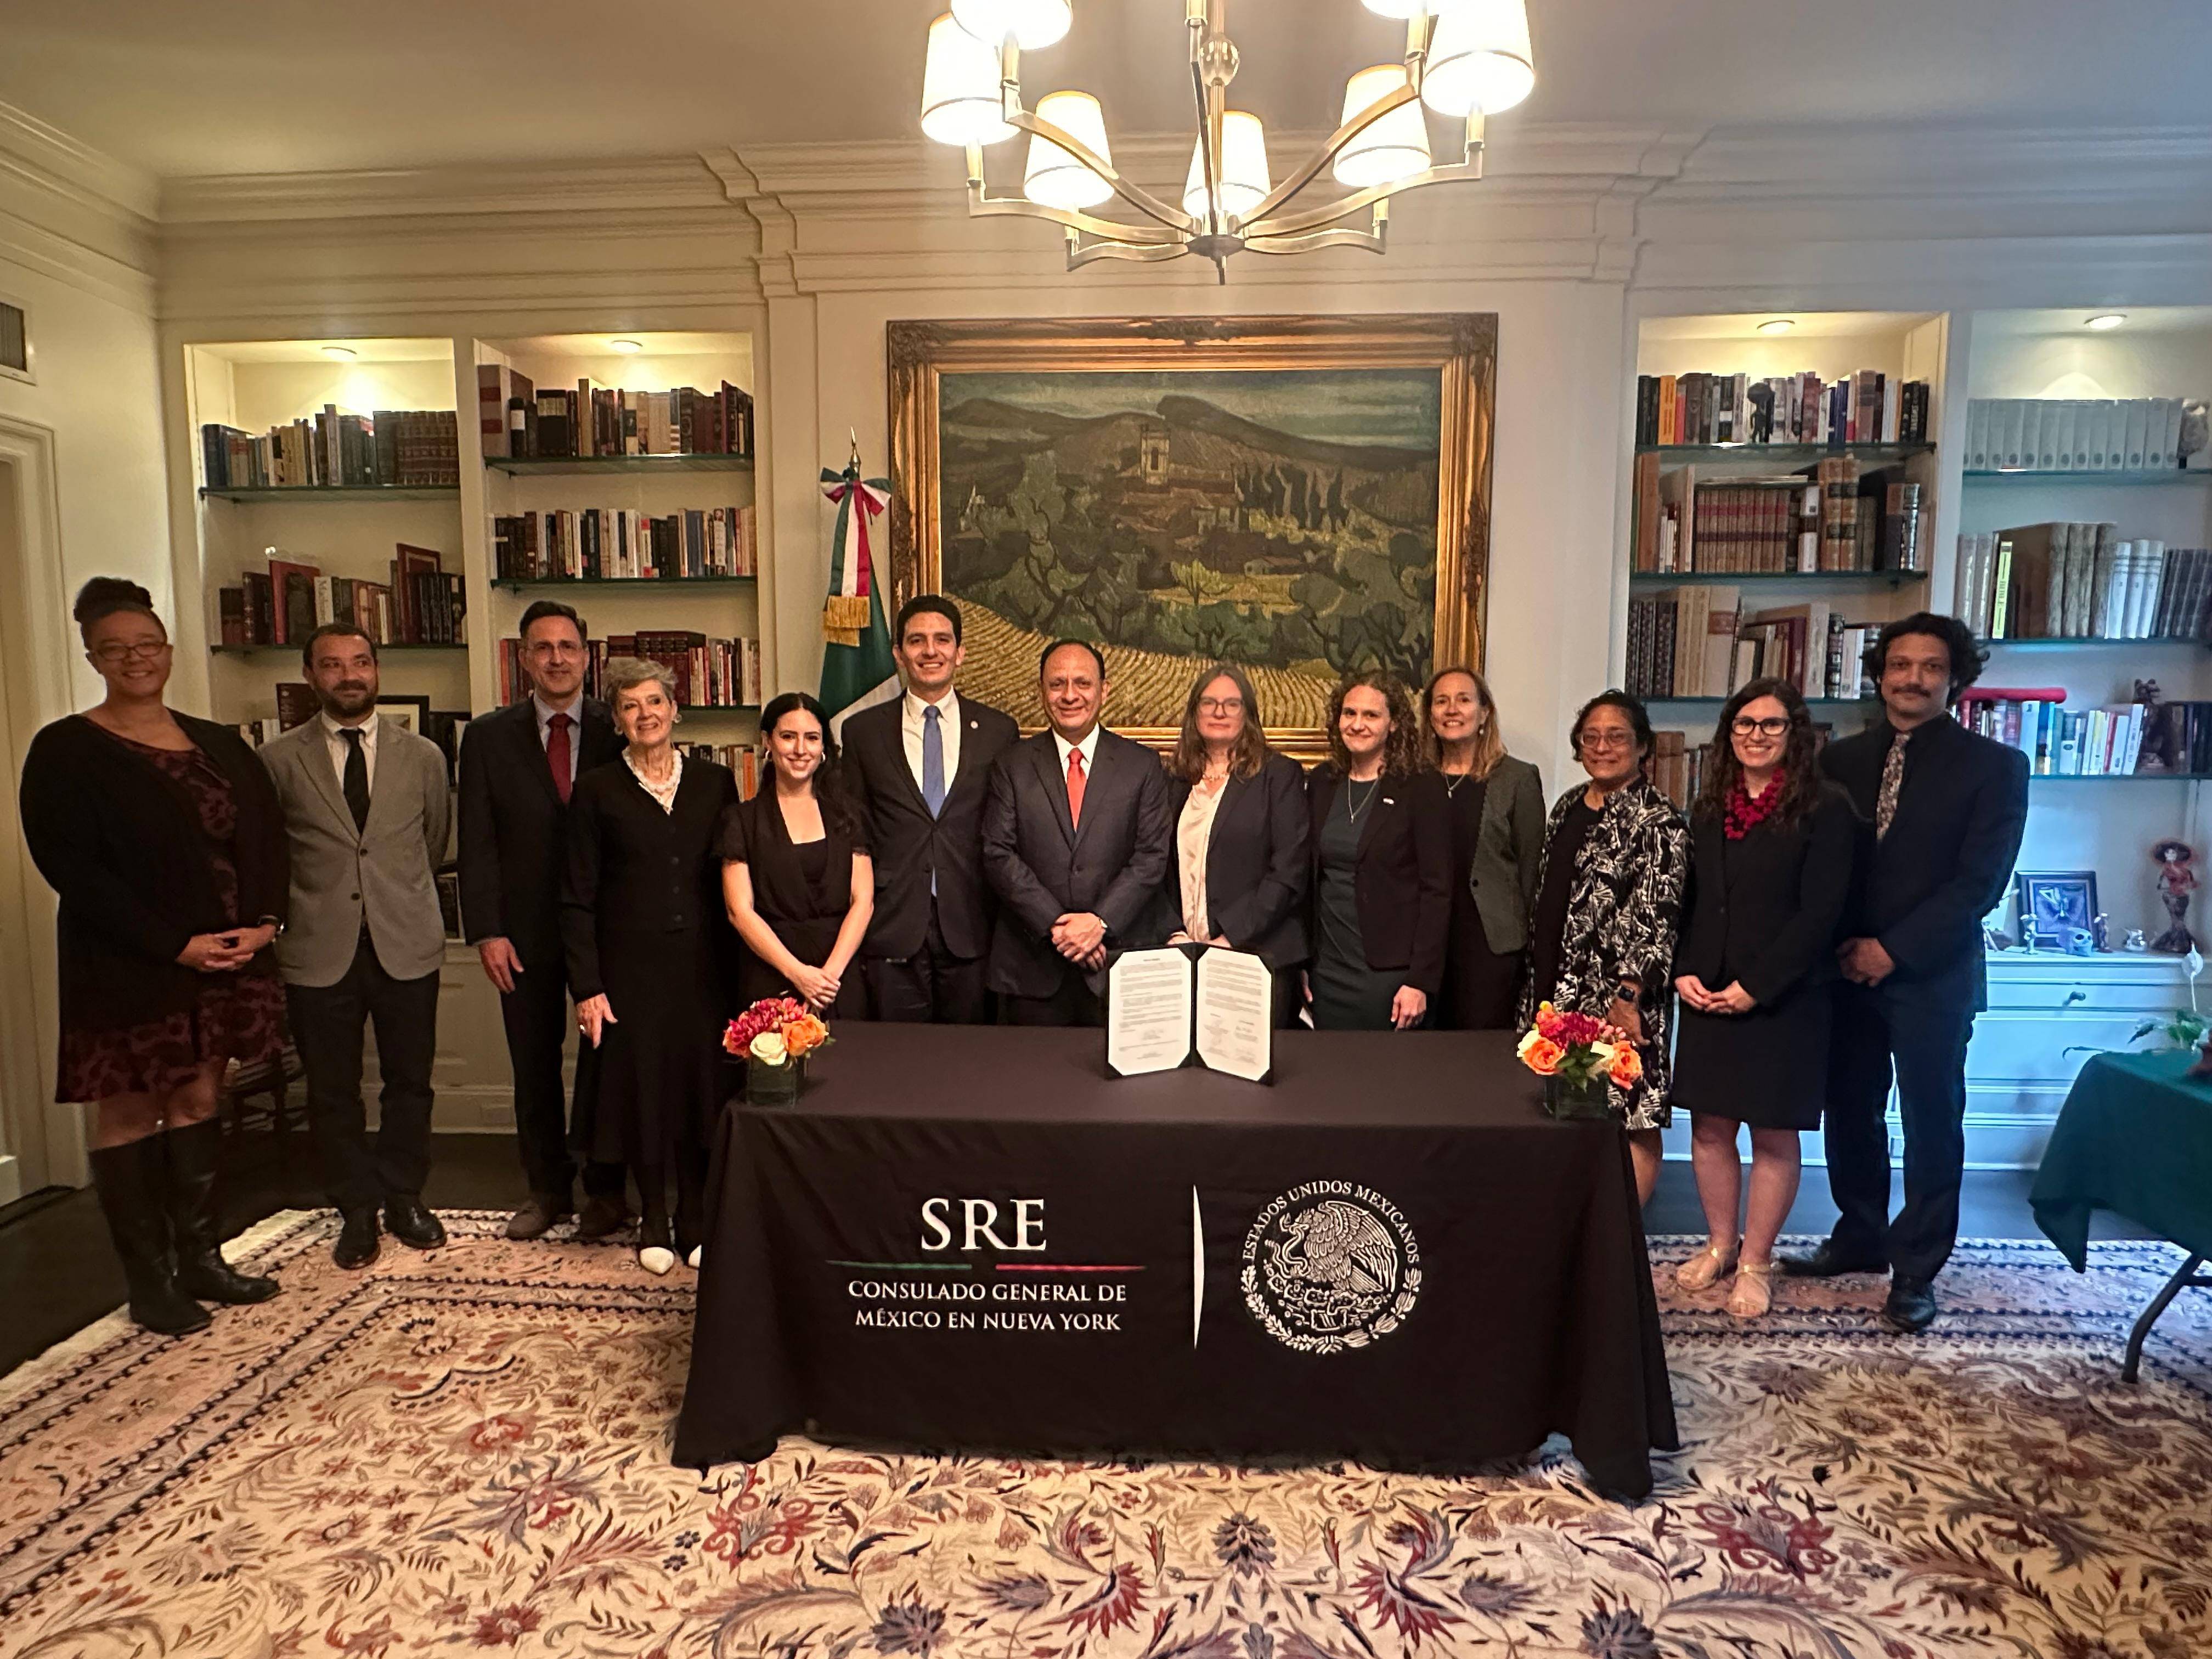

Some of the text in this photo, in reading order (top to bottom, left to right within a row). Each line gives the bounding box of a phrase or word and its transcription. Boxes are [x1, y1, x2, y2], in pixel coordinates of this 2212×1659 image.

[921, 1198, 1047, 1251] SRE
[1242, 1180, 1420, 1264] ESTADOS UNIDOS MEXICANOS
[848, 1280, 1127, 1302] CONSULADO GENERAL DE
[855, 1308, 1122, 1331] MÉXICO EN NUEVA YORK
